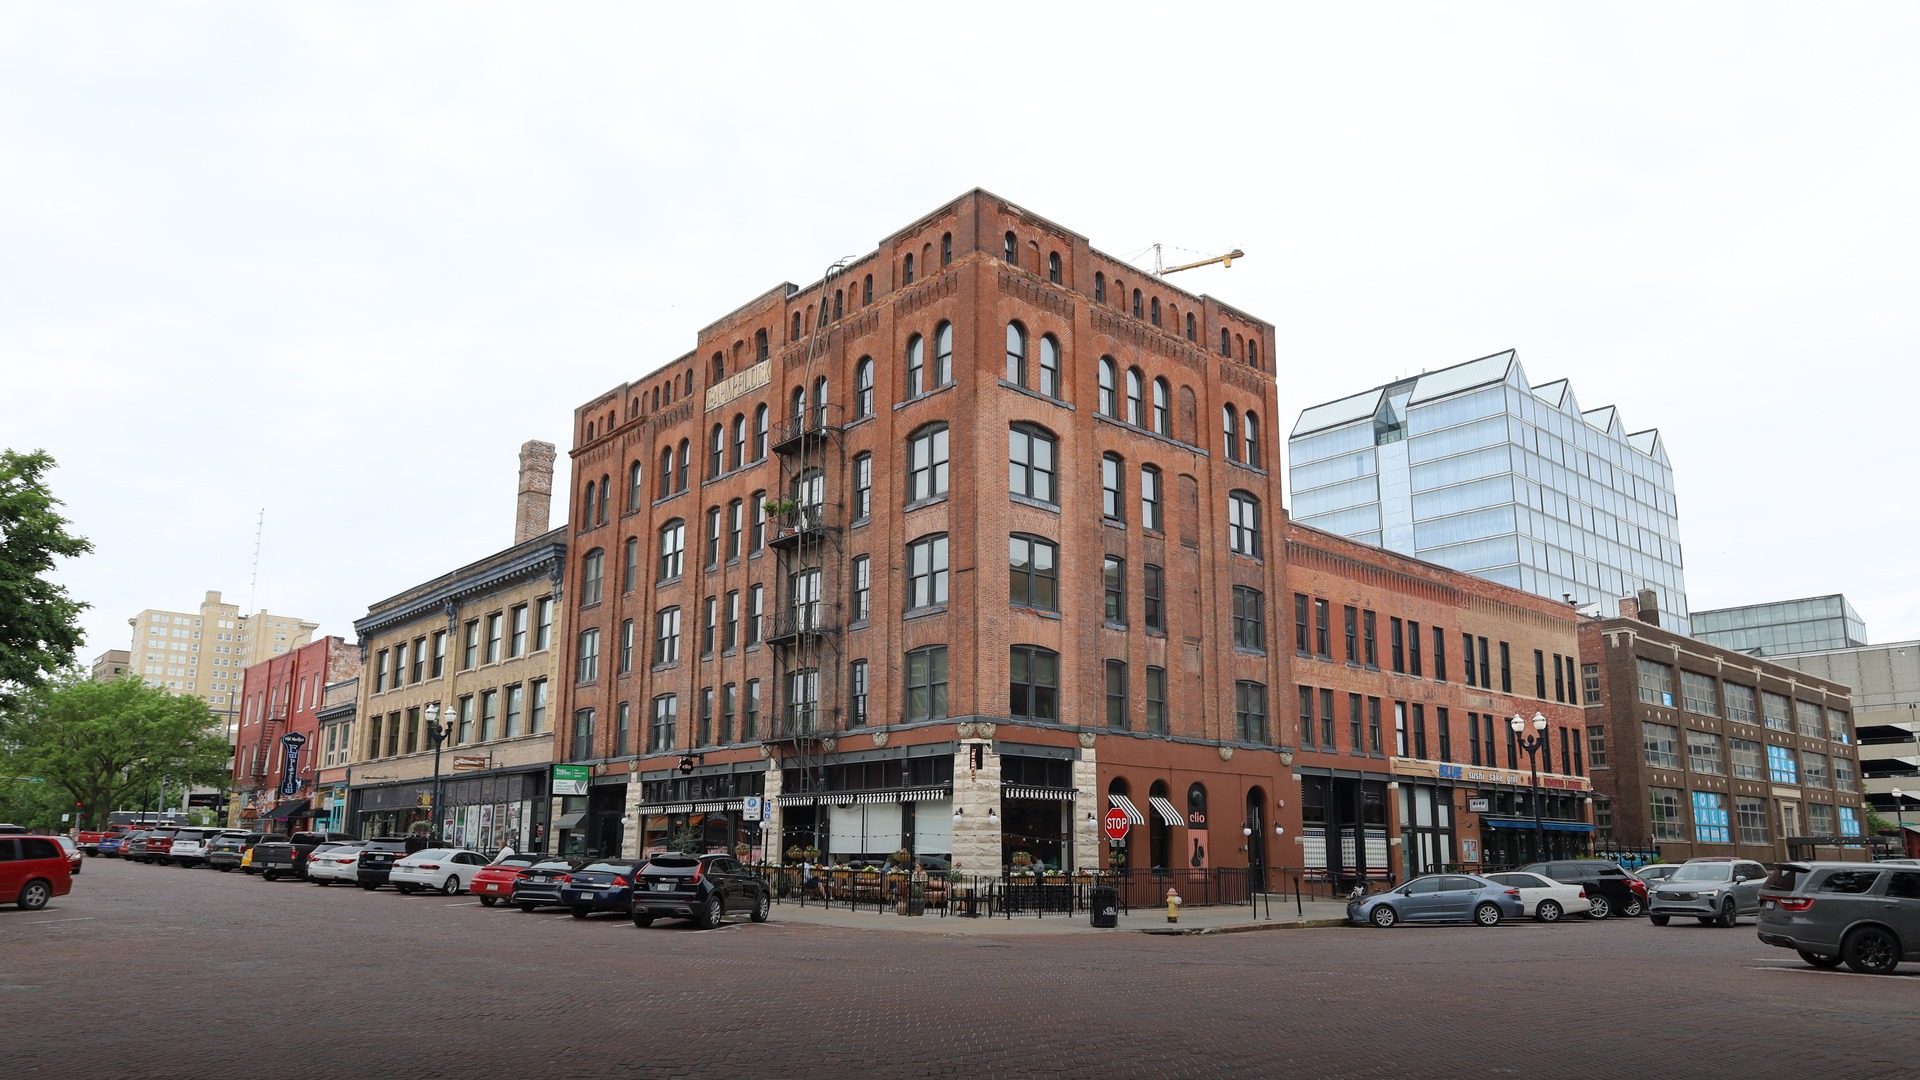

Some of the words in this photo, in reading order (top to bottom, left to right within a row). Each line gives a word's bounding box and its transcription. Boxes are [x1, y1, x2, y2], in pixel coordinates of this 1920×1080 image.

[1439, 764, 1462, 779] BLUE
[1468, 771, 1485, 780] sushi
[1488, 773, 1503, 782] sake
[1506, 775, 1518, 784] grill
[1106, 817, 1127, 830] STOP
[1189, 811, 1205, 823] clio
